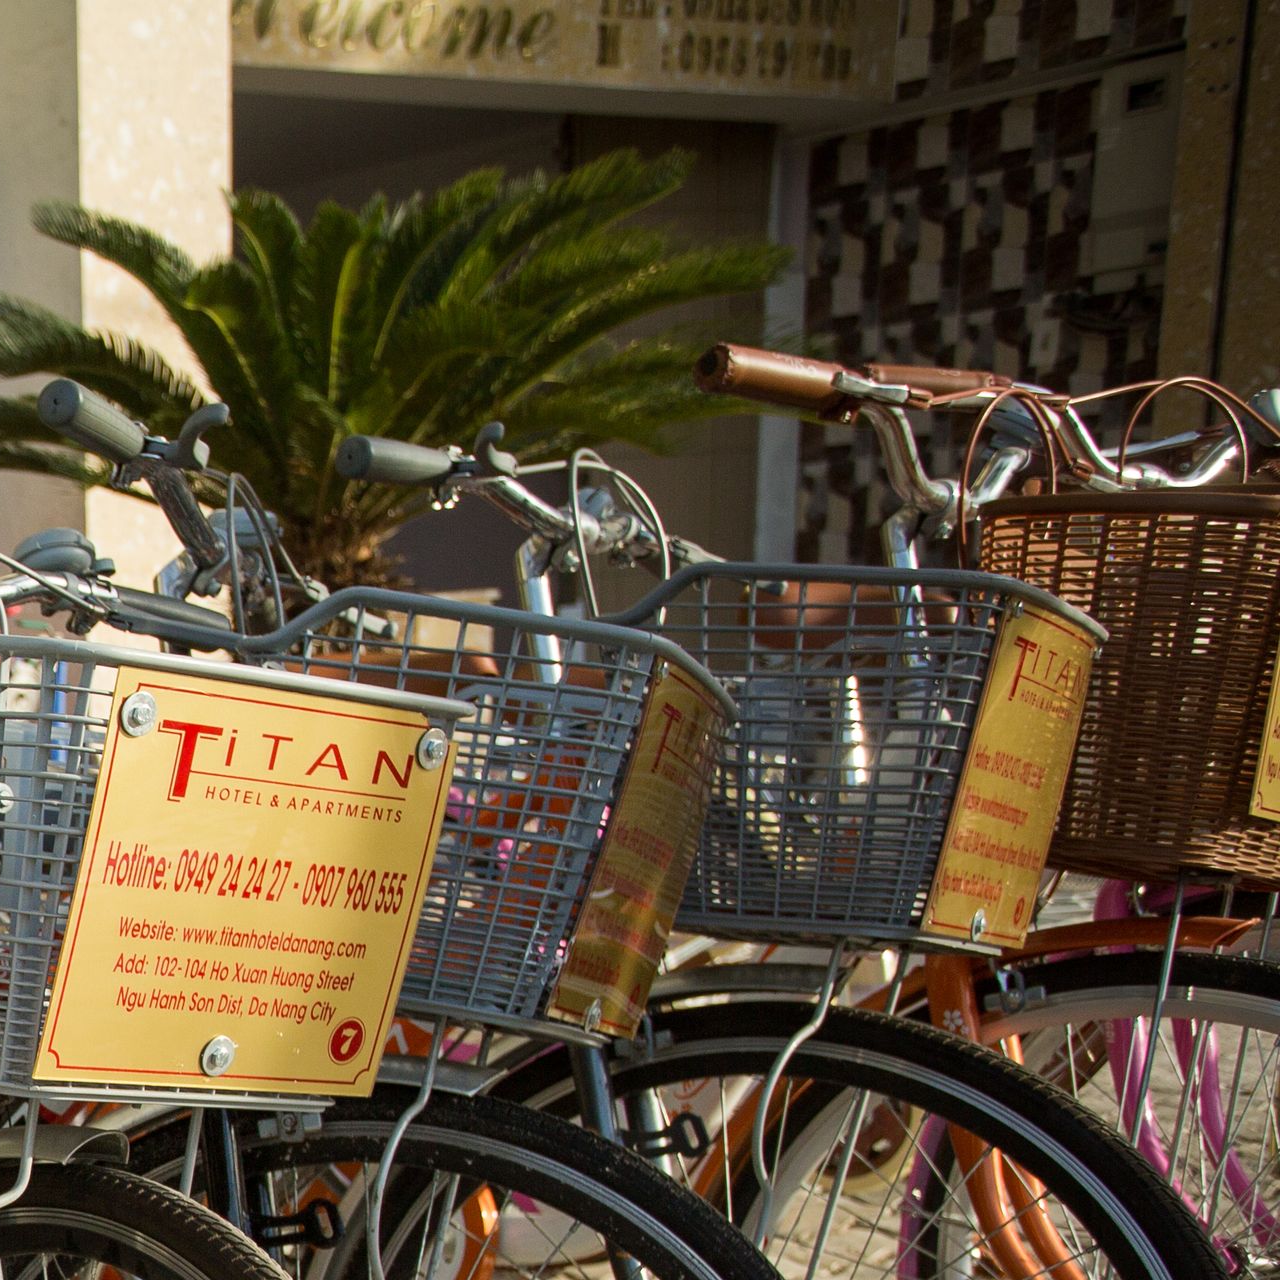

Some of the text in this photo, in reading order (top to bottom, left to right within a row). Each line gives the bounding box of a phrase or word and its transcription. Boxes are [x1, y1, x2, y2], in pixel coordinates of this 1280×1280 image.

[205, 785, 401, 822] HOTEL & APARTMENTS
[103, 841, 171, 890] Hotline:
[174, 849, 219, 894] 0949
[217, 854, 243, 896] 24
[242, 857, 267, 899] 24
[266, 859, 292, 901] 27
[302, 864, 345, 907] 0907
[344, 868, 376, 911] 960
[375, 872, 407, 914] 555
[120, 917, 366, 960] Website: www.titanhoteldanang.com
[114, 953, 354, 993] Add: 102-104 Ho Xuan Huong Street
[117, 986, 336, 1025] Ngu Hanh Son Dist, Da Nang City
[339, 1027, 356, 1056] 7
